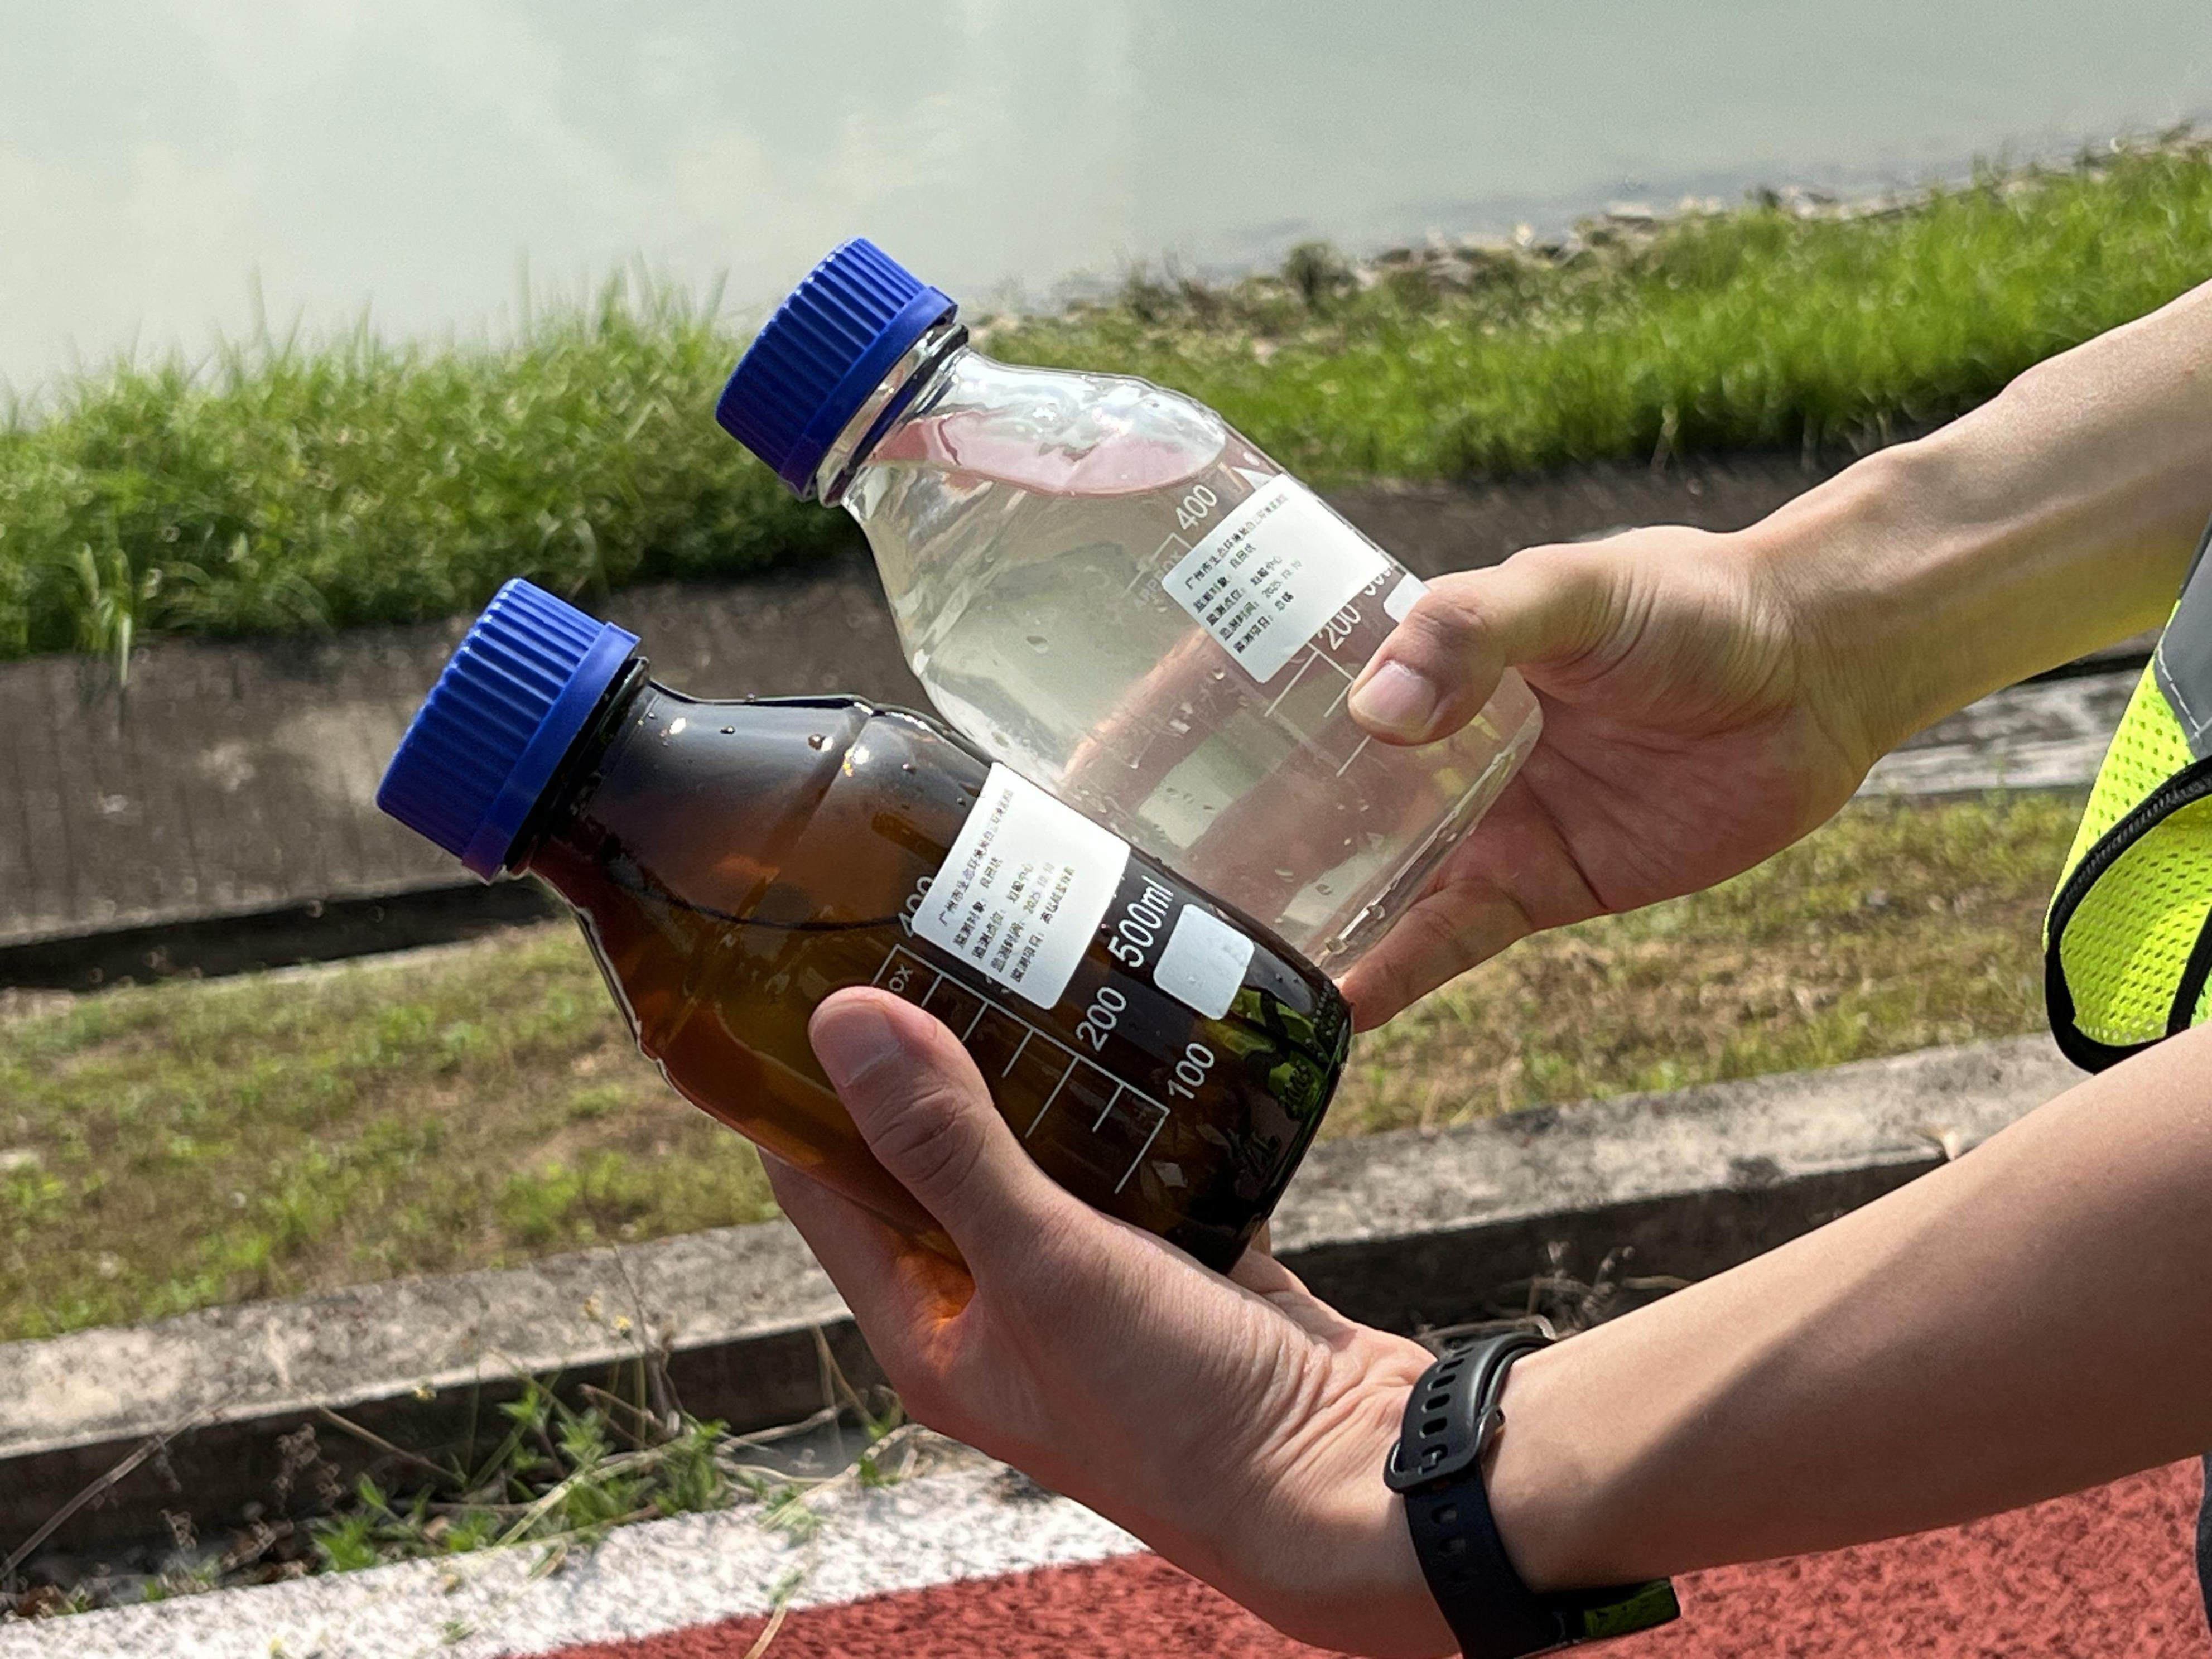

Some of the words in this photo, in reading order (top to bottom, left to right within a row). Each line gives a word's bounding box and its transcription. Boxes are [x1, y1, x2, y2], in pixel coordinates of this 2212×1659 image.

[1175, 484, 1217, 530] 400
[1107, 875, 1174, 968] 500ml
[1076, 986, 1127, 1052] 200
[1168, 1043, 1215, 1099] 100
